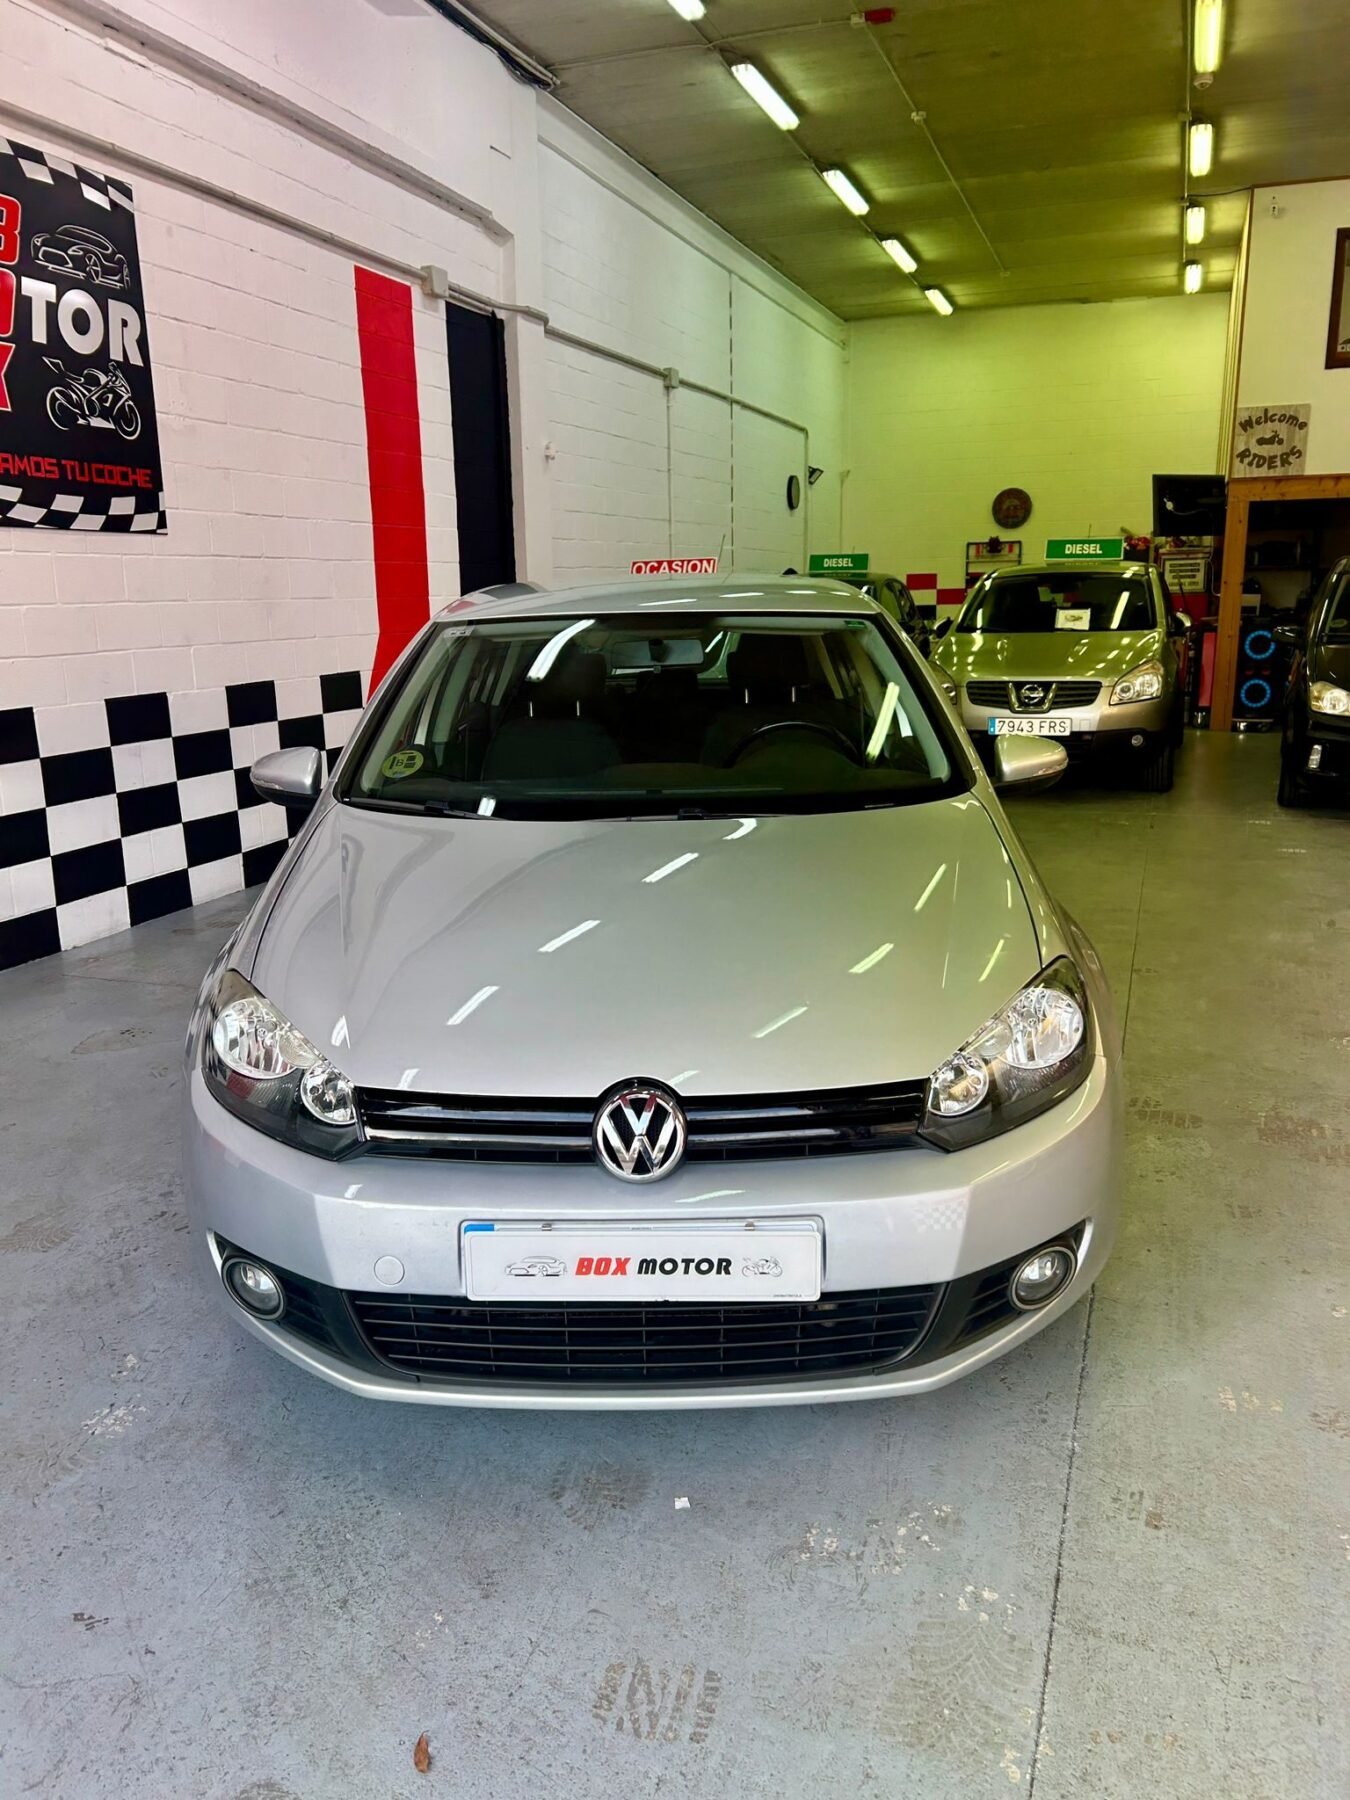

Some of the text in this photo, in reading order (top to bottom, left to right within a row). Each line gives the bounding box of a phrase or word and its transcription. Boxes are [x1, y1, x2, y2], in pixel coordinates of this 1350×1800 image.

[1238, 408, 1308, 433] Welcome
[1236, 445, 1303, 471] RIDERS
[62, 459, 90, 482] TU
[92, 463, 153, 488] COCHE
[1064, 543, 1103, 554] DIESEL
[632, 559, 715, 575] OCASION
[823, 557, 854, 568] DIESEL
[998, 720, 1067, 734] 7943 FRS
[575, 1257, 733, 1276] BOX MOTOR
